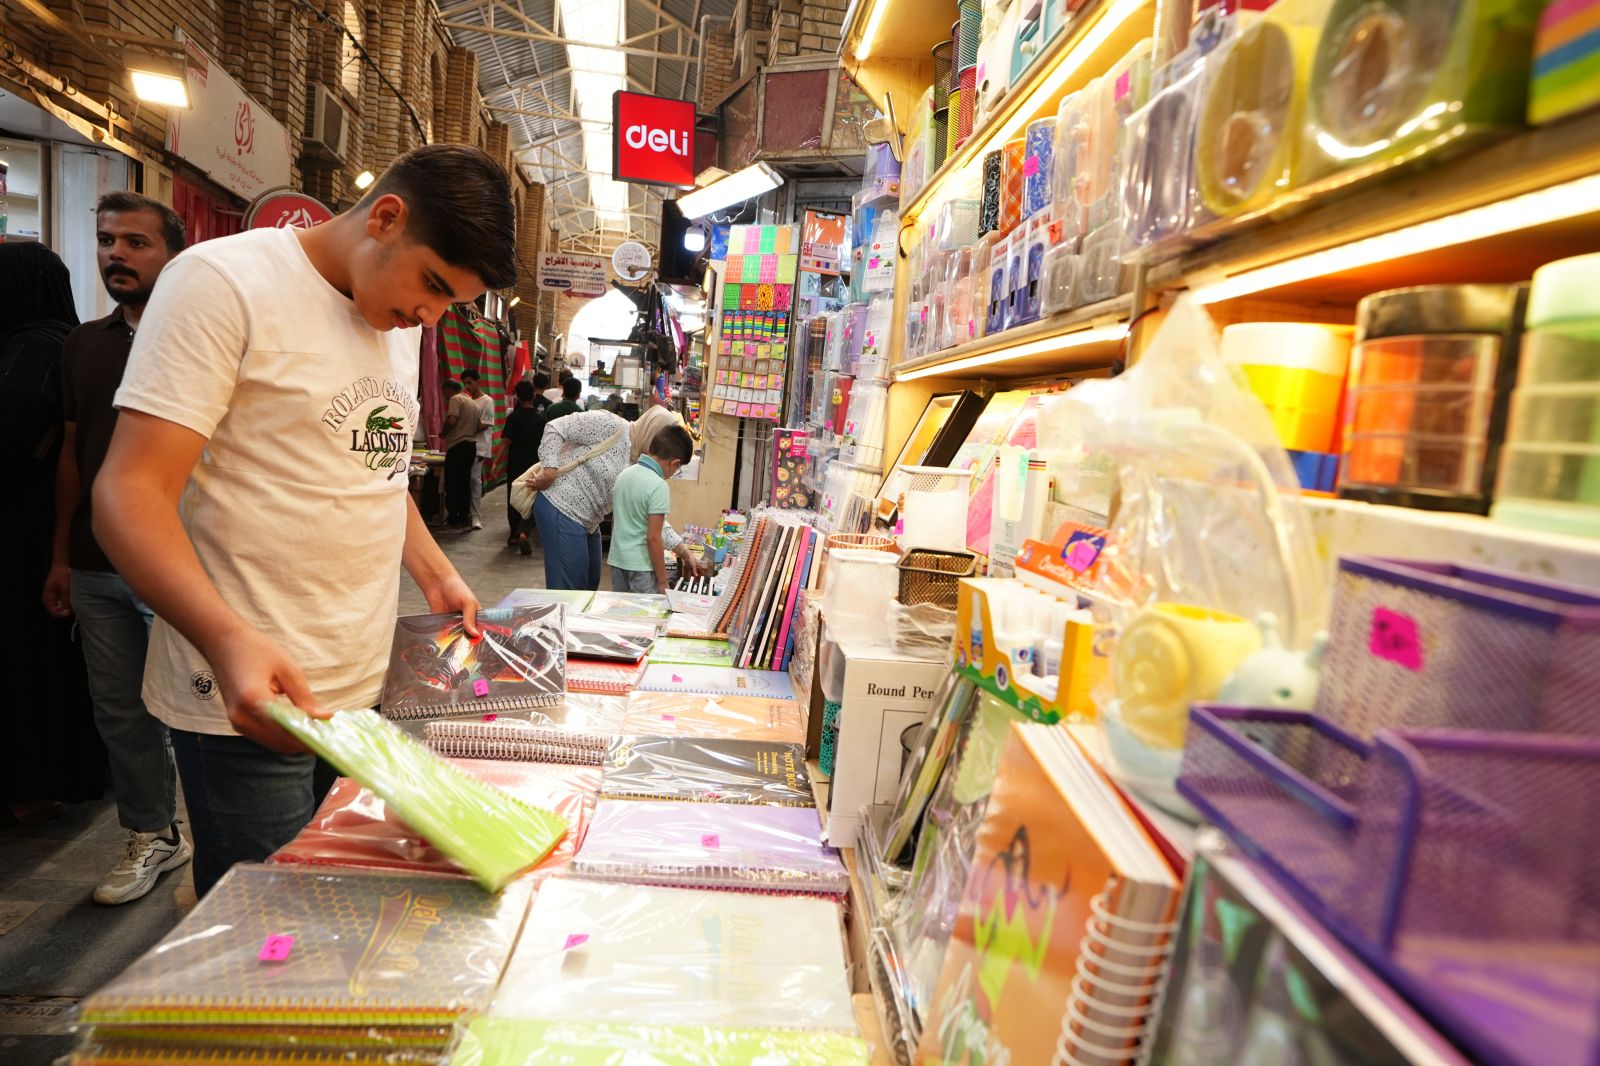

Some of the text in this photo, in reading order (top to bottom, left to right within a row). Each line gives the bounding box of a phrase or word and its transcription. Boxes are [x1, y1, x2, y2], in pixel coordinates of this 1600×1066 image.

[625, 124, 689, 156] deli
[321, 376, 382, 432] ROLAND
[349, 429, 409, 453] LACOSTE
[364, 448, 397, 471] Club
[867, 682, 935, 699] Round Per
[783, 751, 795, 772] NOTE
[388, 893, 452, 954] Delue
[727, 911, 764, 975] Delue
